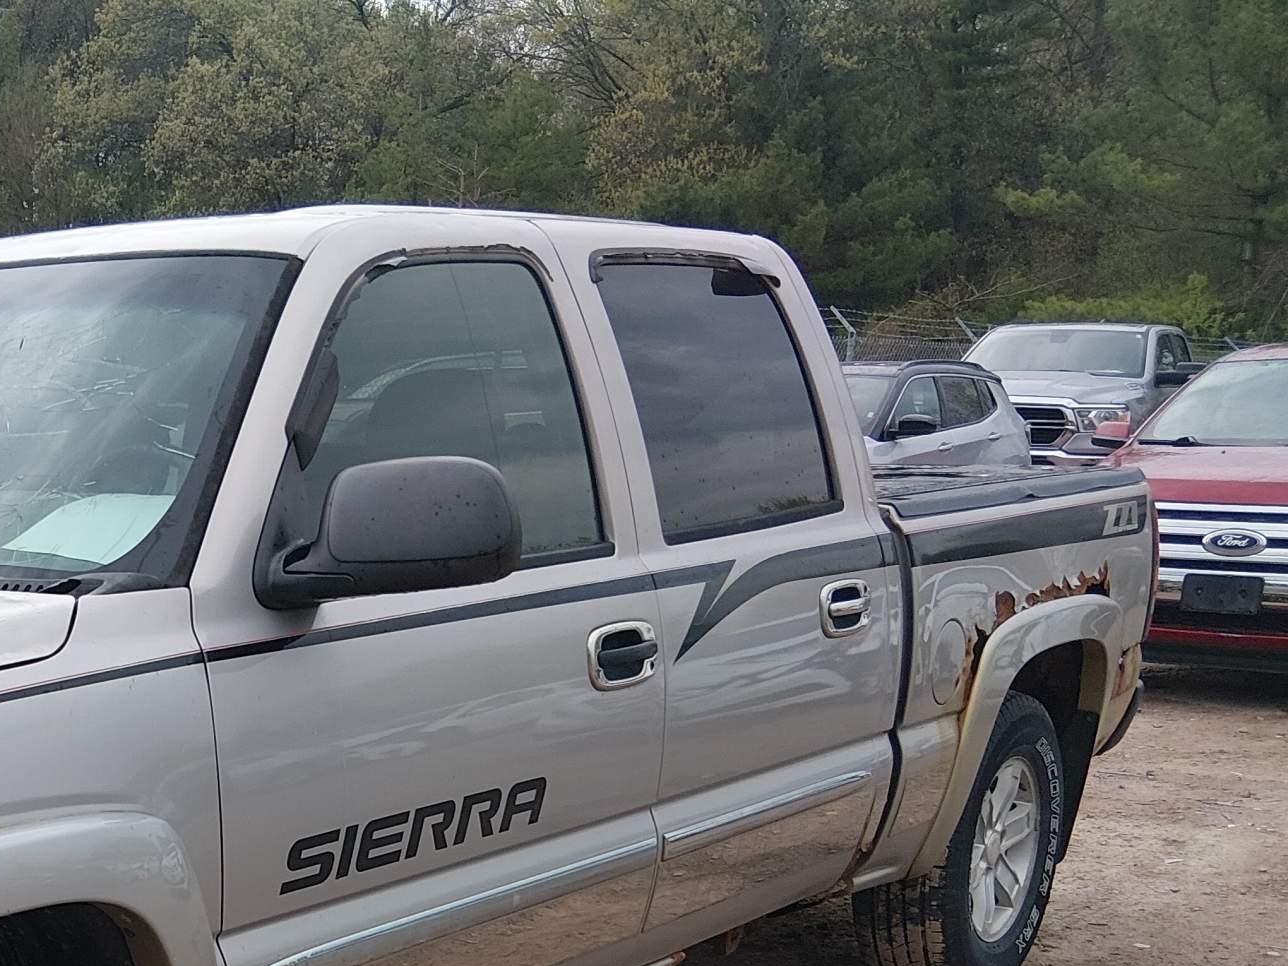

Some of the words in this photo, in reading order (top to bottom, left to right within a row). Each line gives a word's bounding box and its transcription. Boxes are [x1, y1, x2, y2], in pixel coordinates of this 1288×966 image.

[1216, 534, 1250, 548] Ford
[279, 776, 547, 896] SIERRA
[1035, 737, 1061, 897] DISCOVERER
